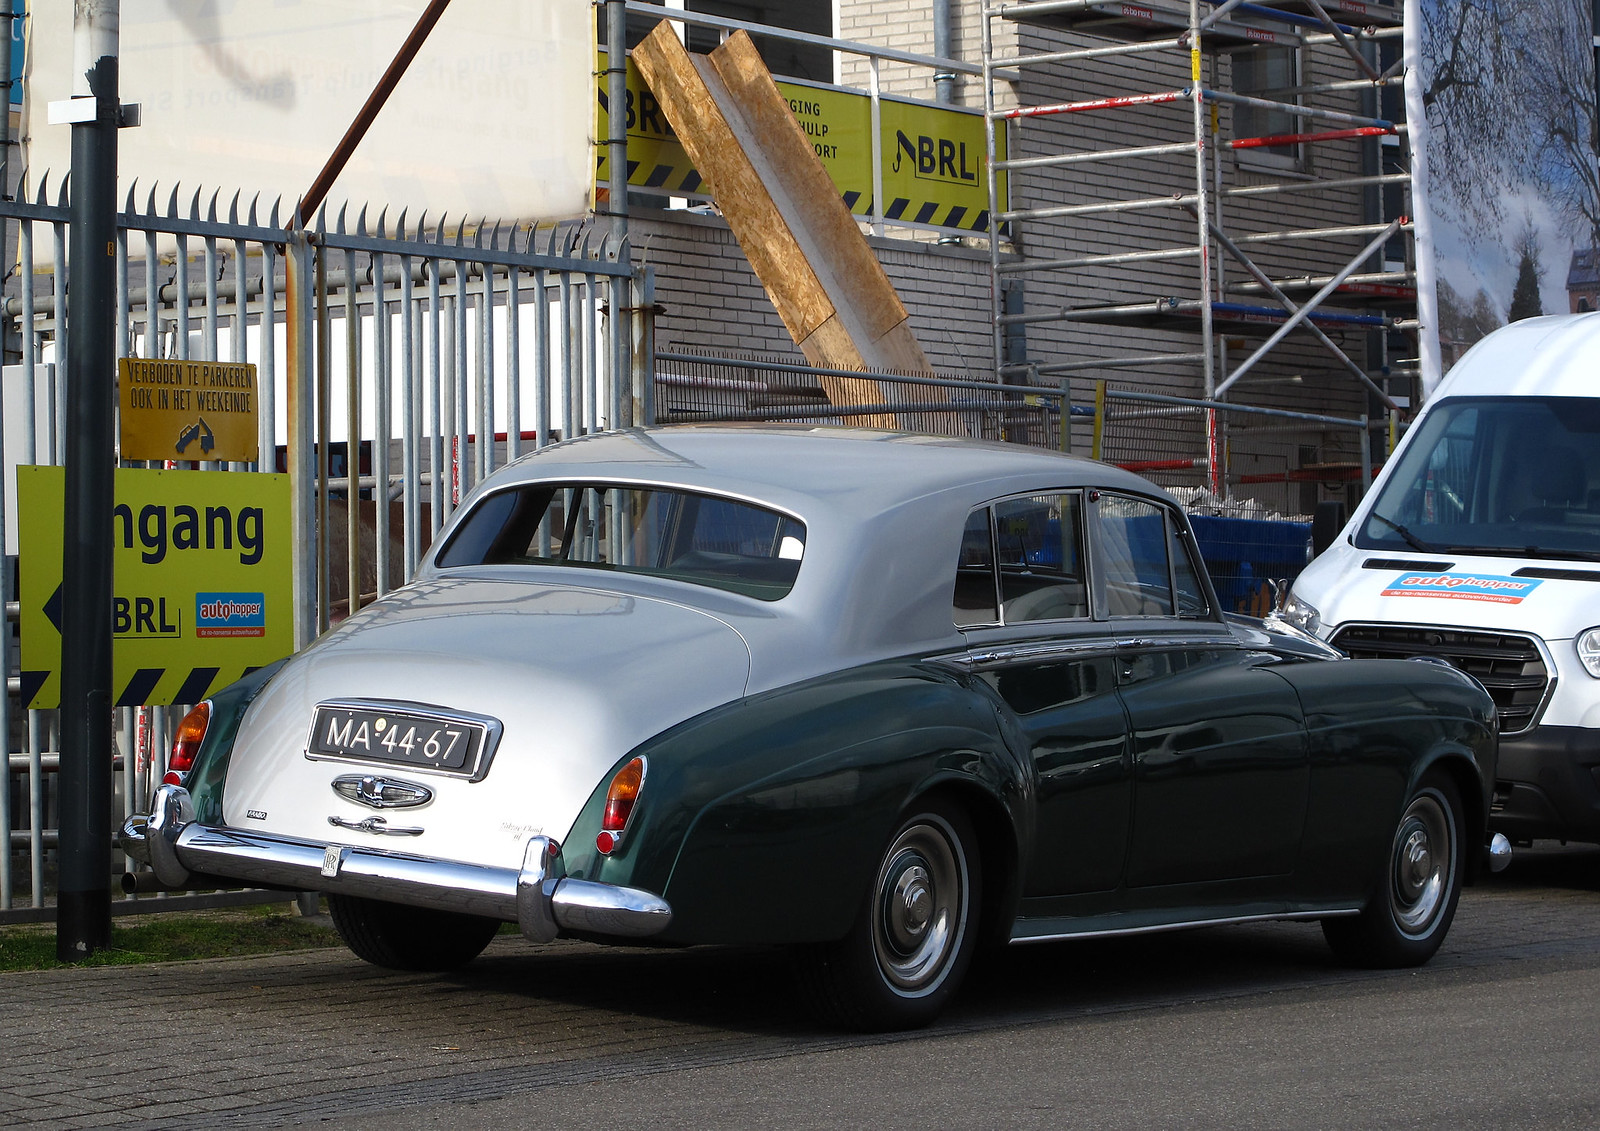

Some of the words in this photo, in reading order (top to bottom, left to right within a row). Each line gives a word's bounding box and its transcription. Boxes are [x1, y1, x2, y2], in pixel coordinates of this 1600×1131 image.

[784, 98, 820, 116] GING
[799, 120, 829, 137] HULP
[811, 143, 837, 159] ORT
[918, 135, 975, 180] BRL
[127, 360, 182, 385] VERBODEN
[187, 364, 199, 386] TE
[203, 364, 252, 388] PARKEREN
[131, 387, 153, 409] OOK
[158, 387, 168, 409] IN
[173, 388, 191, 410] HET
[196, 390, 251, 413] WEEKEINDE
[113, 503, 264, 565] ngang
[1401, 576, 1531, 590] autohopper
[113, 597, 176, 633] BRL
[201, 600, 261, 622] autohopper
